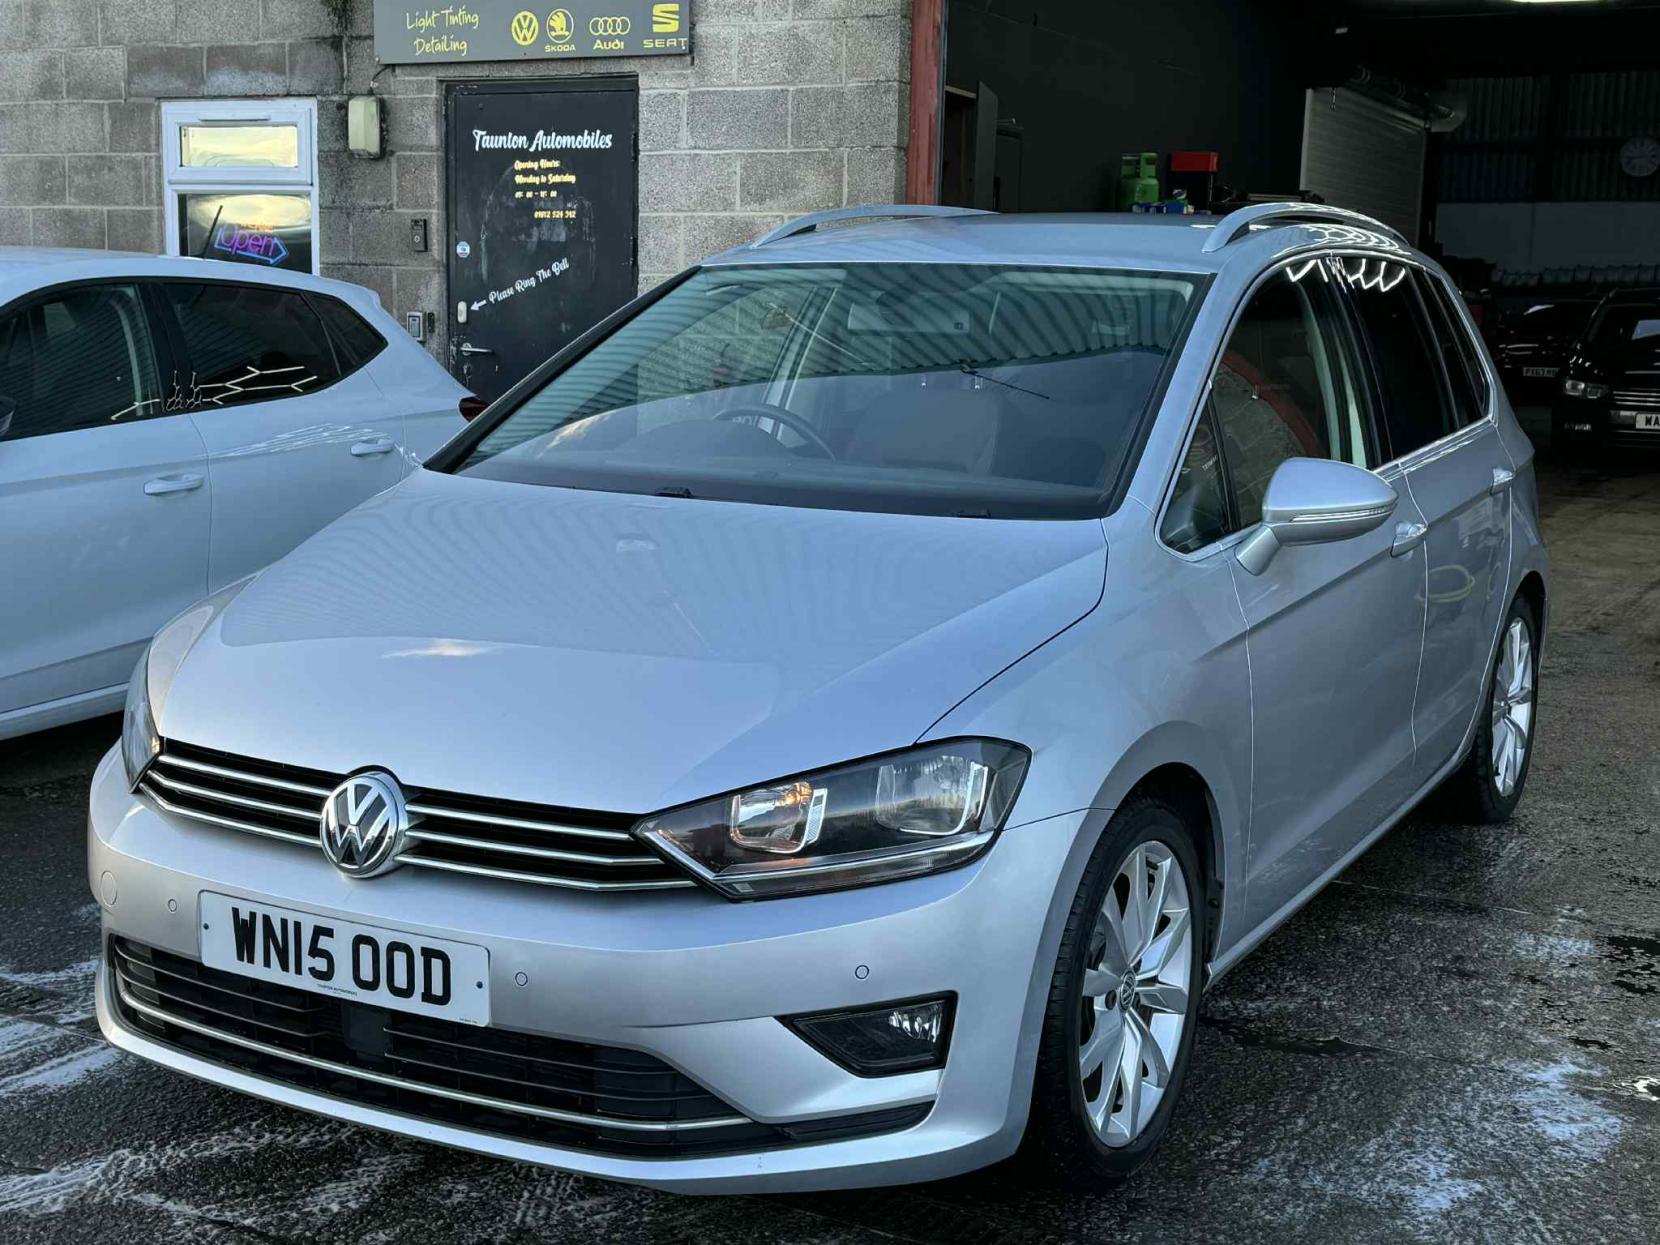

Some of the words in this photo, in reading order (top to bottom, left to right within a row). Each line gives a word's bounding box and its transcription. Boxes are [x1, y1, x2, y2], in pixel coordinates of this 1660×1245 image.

[406, 10, 440, 33] Light
[441, 5, 479, 29] Tinting
[414, 34, 468, 56] Detailing
[593, 39, 625, 50] Audi
[643, 38, 688, 49] SEAT
[472, 129, 529, 152] Taunton
[529, 129, 612, 152] Automobiles
[221, 223, 274, 255] Open
[488, 287, 515, 304] Please
[515, 276, 536, 292] Ring
[535, 268, 552, 283] The
[551, 257, 569, 276] Bell
[231, 906, 335, 982] WN15
[351, 933, 451, 1006] OOD
